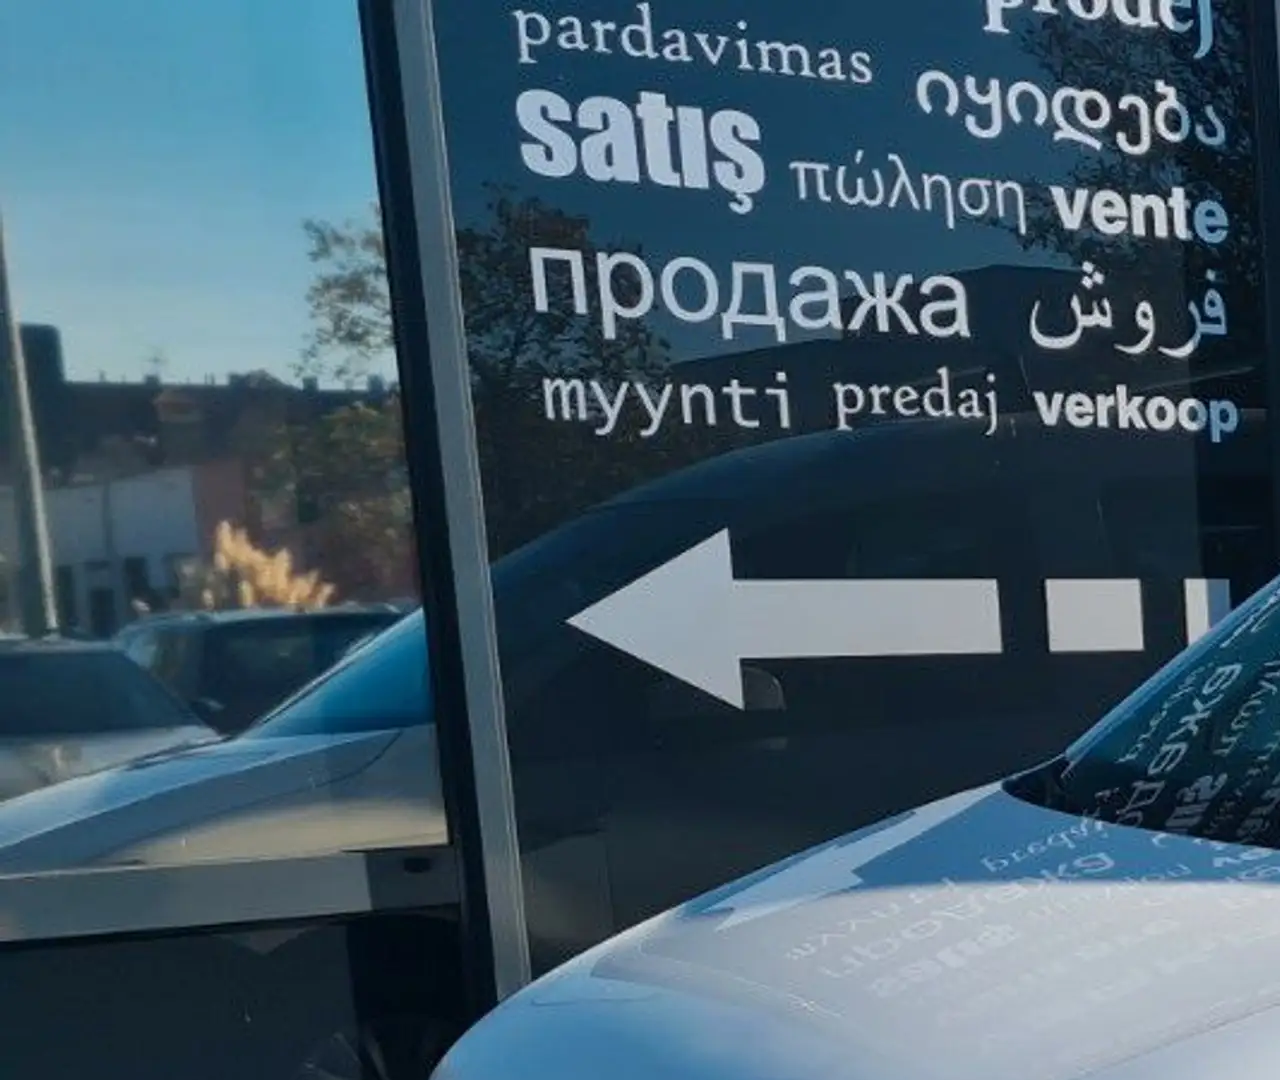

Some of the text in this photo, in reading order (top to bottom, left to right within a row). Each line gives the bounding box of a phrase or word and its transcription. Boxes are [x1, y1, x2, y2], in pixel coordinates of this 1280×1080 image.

[513, 3, 873, 84] pardavimas
[984, 0, 1210, 59] podej
[516, 89, 766, 214] satış
[917, 70, 1226, 155] იყიდება
[790, 150, 1027, 235] πώληση
[1049, 185, 1229, 243] vente
[530, 247, 971, 343] продажа
[1030, 261, 1228, 359] فروش
[543, 371, 790, 437] myynti
[834, 367, 998, 435] predaj
[1033, 384, 1239, 443] verkoop
